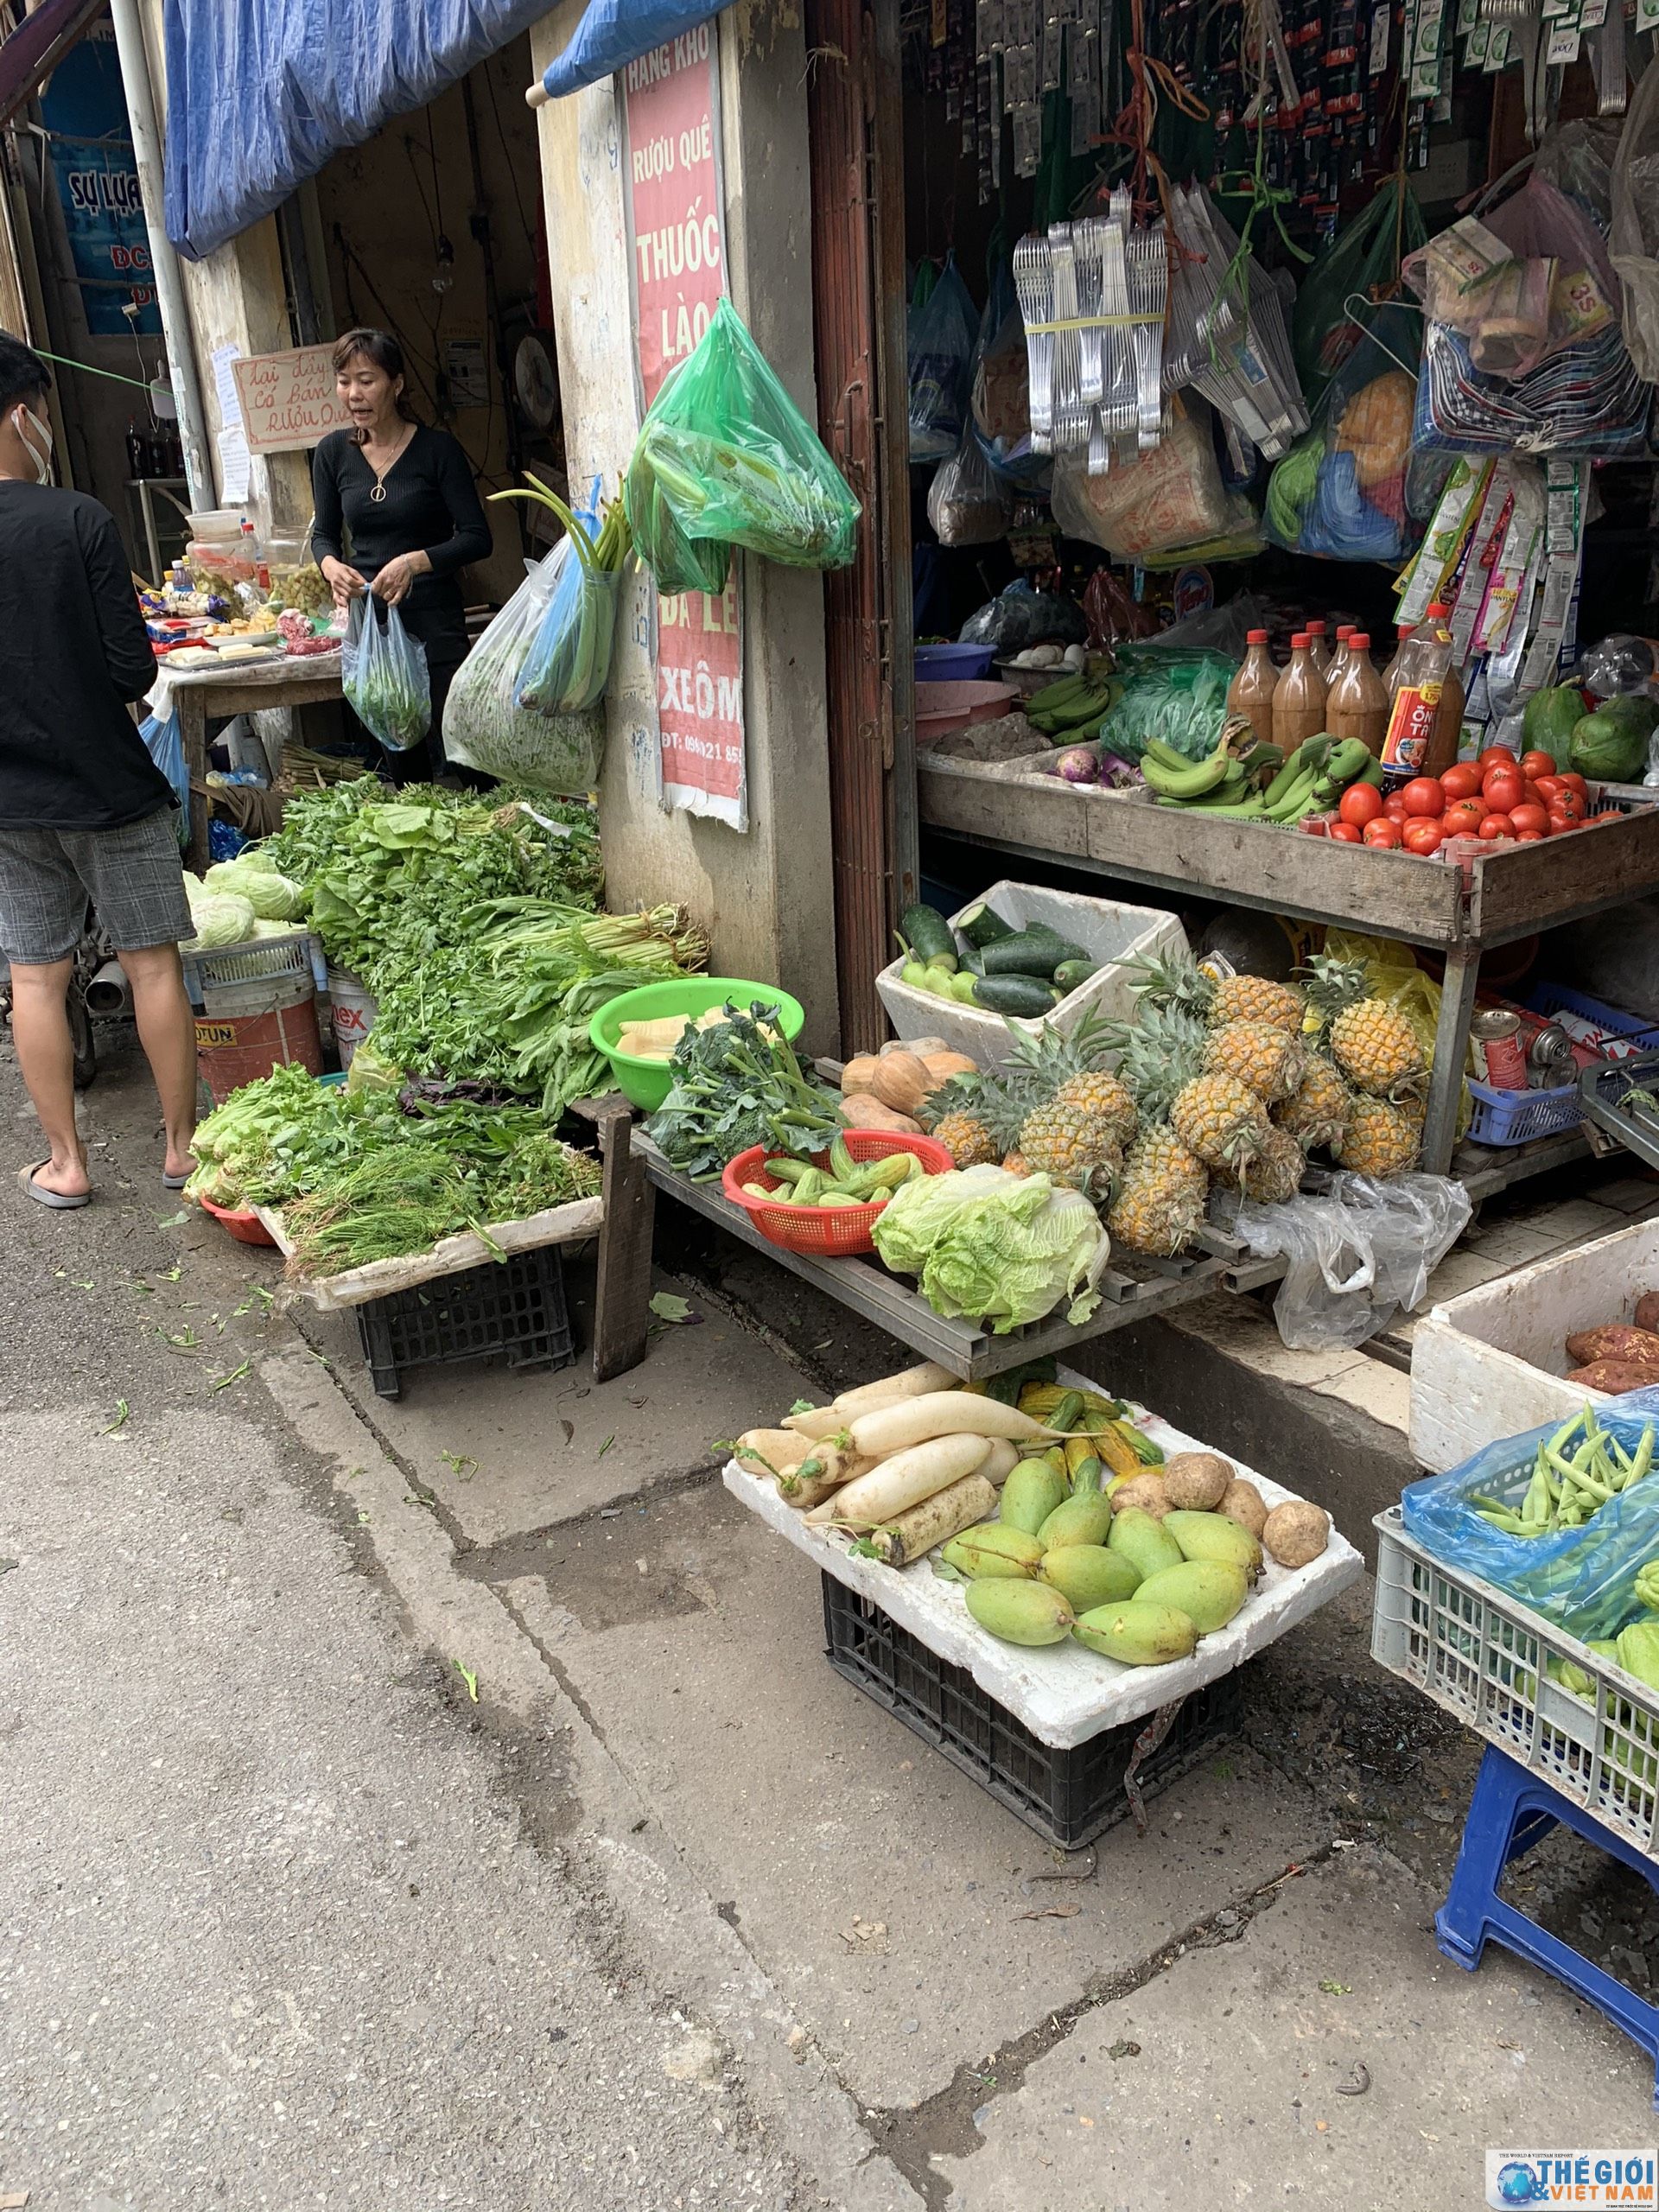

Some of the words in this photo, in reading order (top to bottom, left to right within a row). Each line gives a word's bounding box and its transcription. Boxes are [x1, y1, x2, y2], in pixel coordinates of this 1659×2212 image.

[633, 135, 675, 183] RƯỢU
[678, 114, 711, 170] QUÊ
[69, 170, 99, 215] SỰ
[637, 195, 720, 283] THUỐC
[662, 292, 710, 357] LÀO
[662, 732, 682, 749] ĐT:
